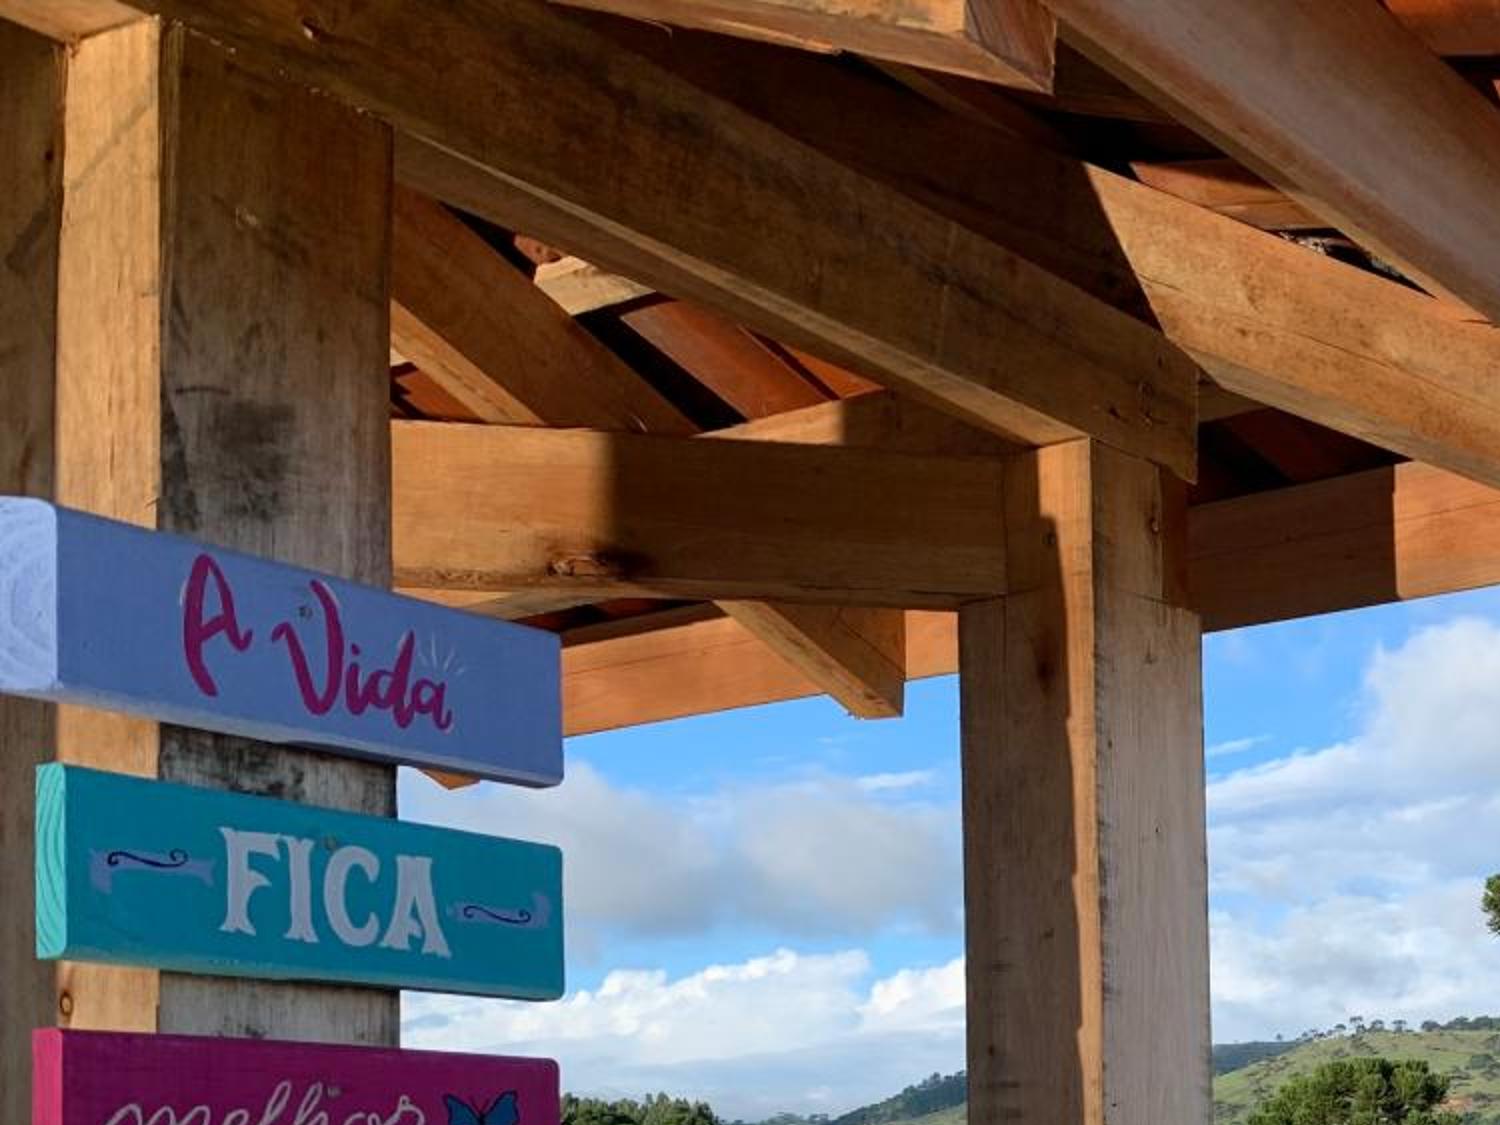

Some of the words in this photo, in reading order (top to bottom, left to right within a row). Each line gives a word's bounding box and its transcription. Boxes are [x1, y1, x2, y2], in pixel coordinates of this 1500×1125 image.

[181, 553, 253, 697] A
[272, 579, 455, 731] Vida
[218, 826, 452, 959] FICA
